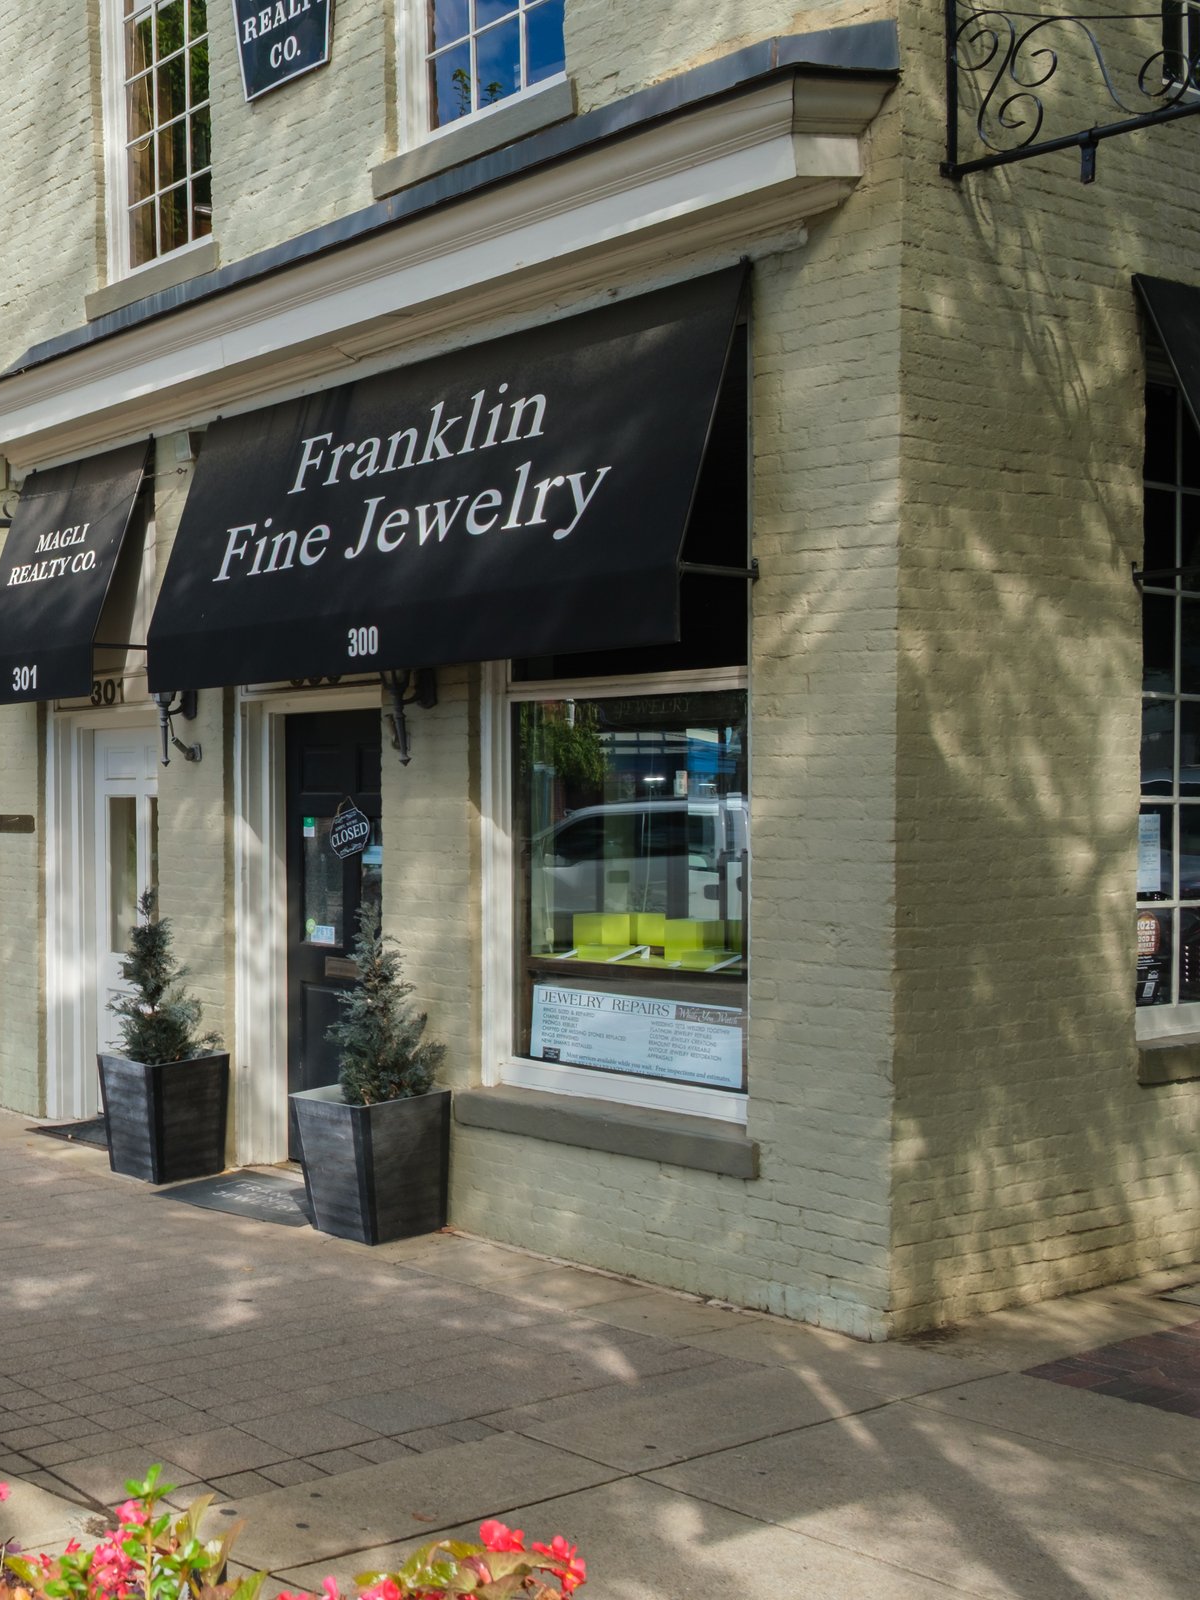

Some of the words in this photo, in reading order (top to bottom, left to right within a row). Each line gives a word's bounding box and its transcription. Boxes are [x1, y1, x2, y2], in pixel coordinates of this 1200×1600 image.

[243, 0, 322, 45] REAL
[270, 36, 301, 68] CO.
[287, 383, 547, 495] Franklin
[212, 518, 331, 582] Fine
[344, 460, 612, 560] Jewelry
[35, 523, 90, 554] MAGLI
[6, 555, 70, 586] REALTY
[71, 550, 97, 574] CO.
[348, 626, 378, 657] 300
[12, 664, 37, 691] 301
[91, 677, 125, 706] 301
[331, 822, 369, 848] CLOSED
[542, 991, 605, 1008] JEWELRY
[612, 998, 670, 1016] REPAIRS
